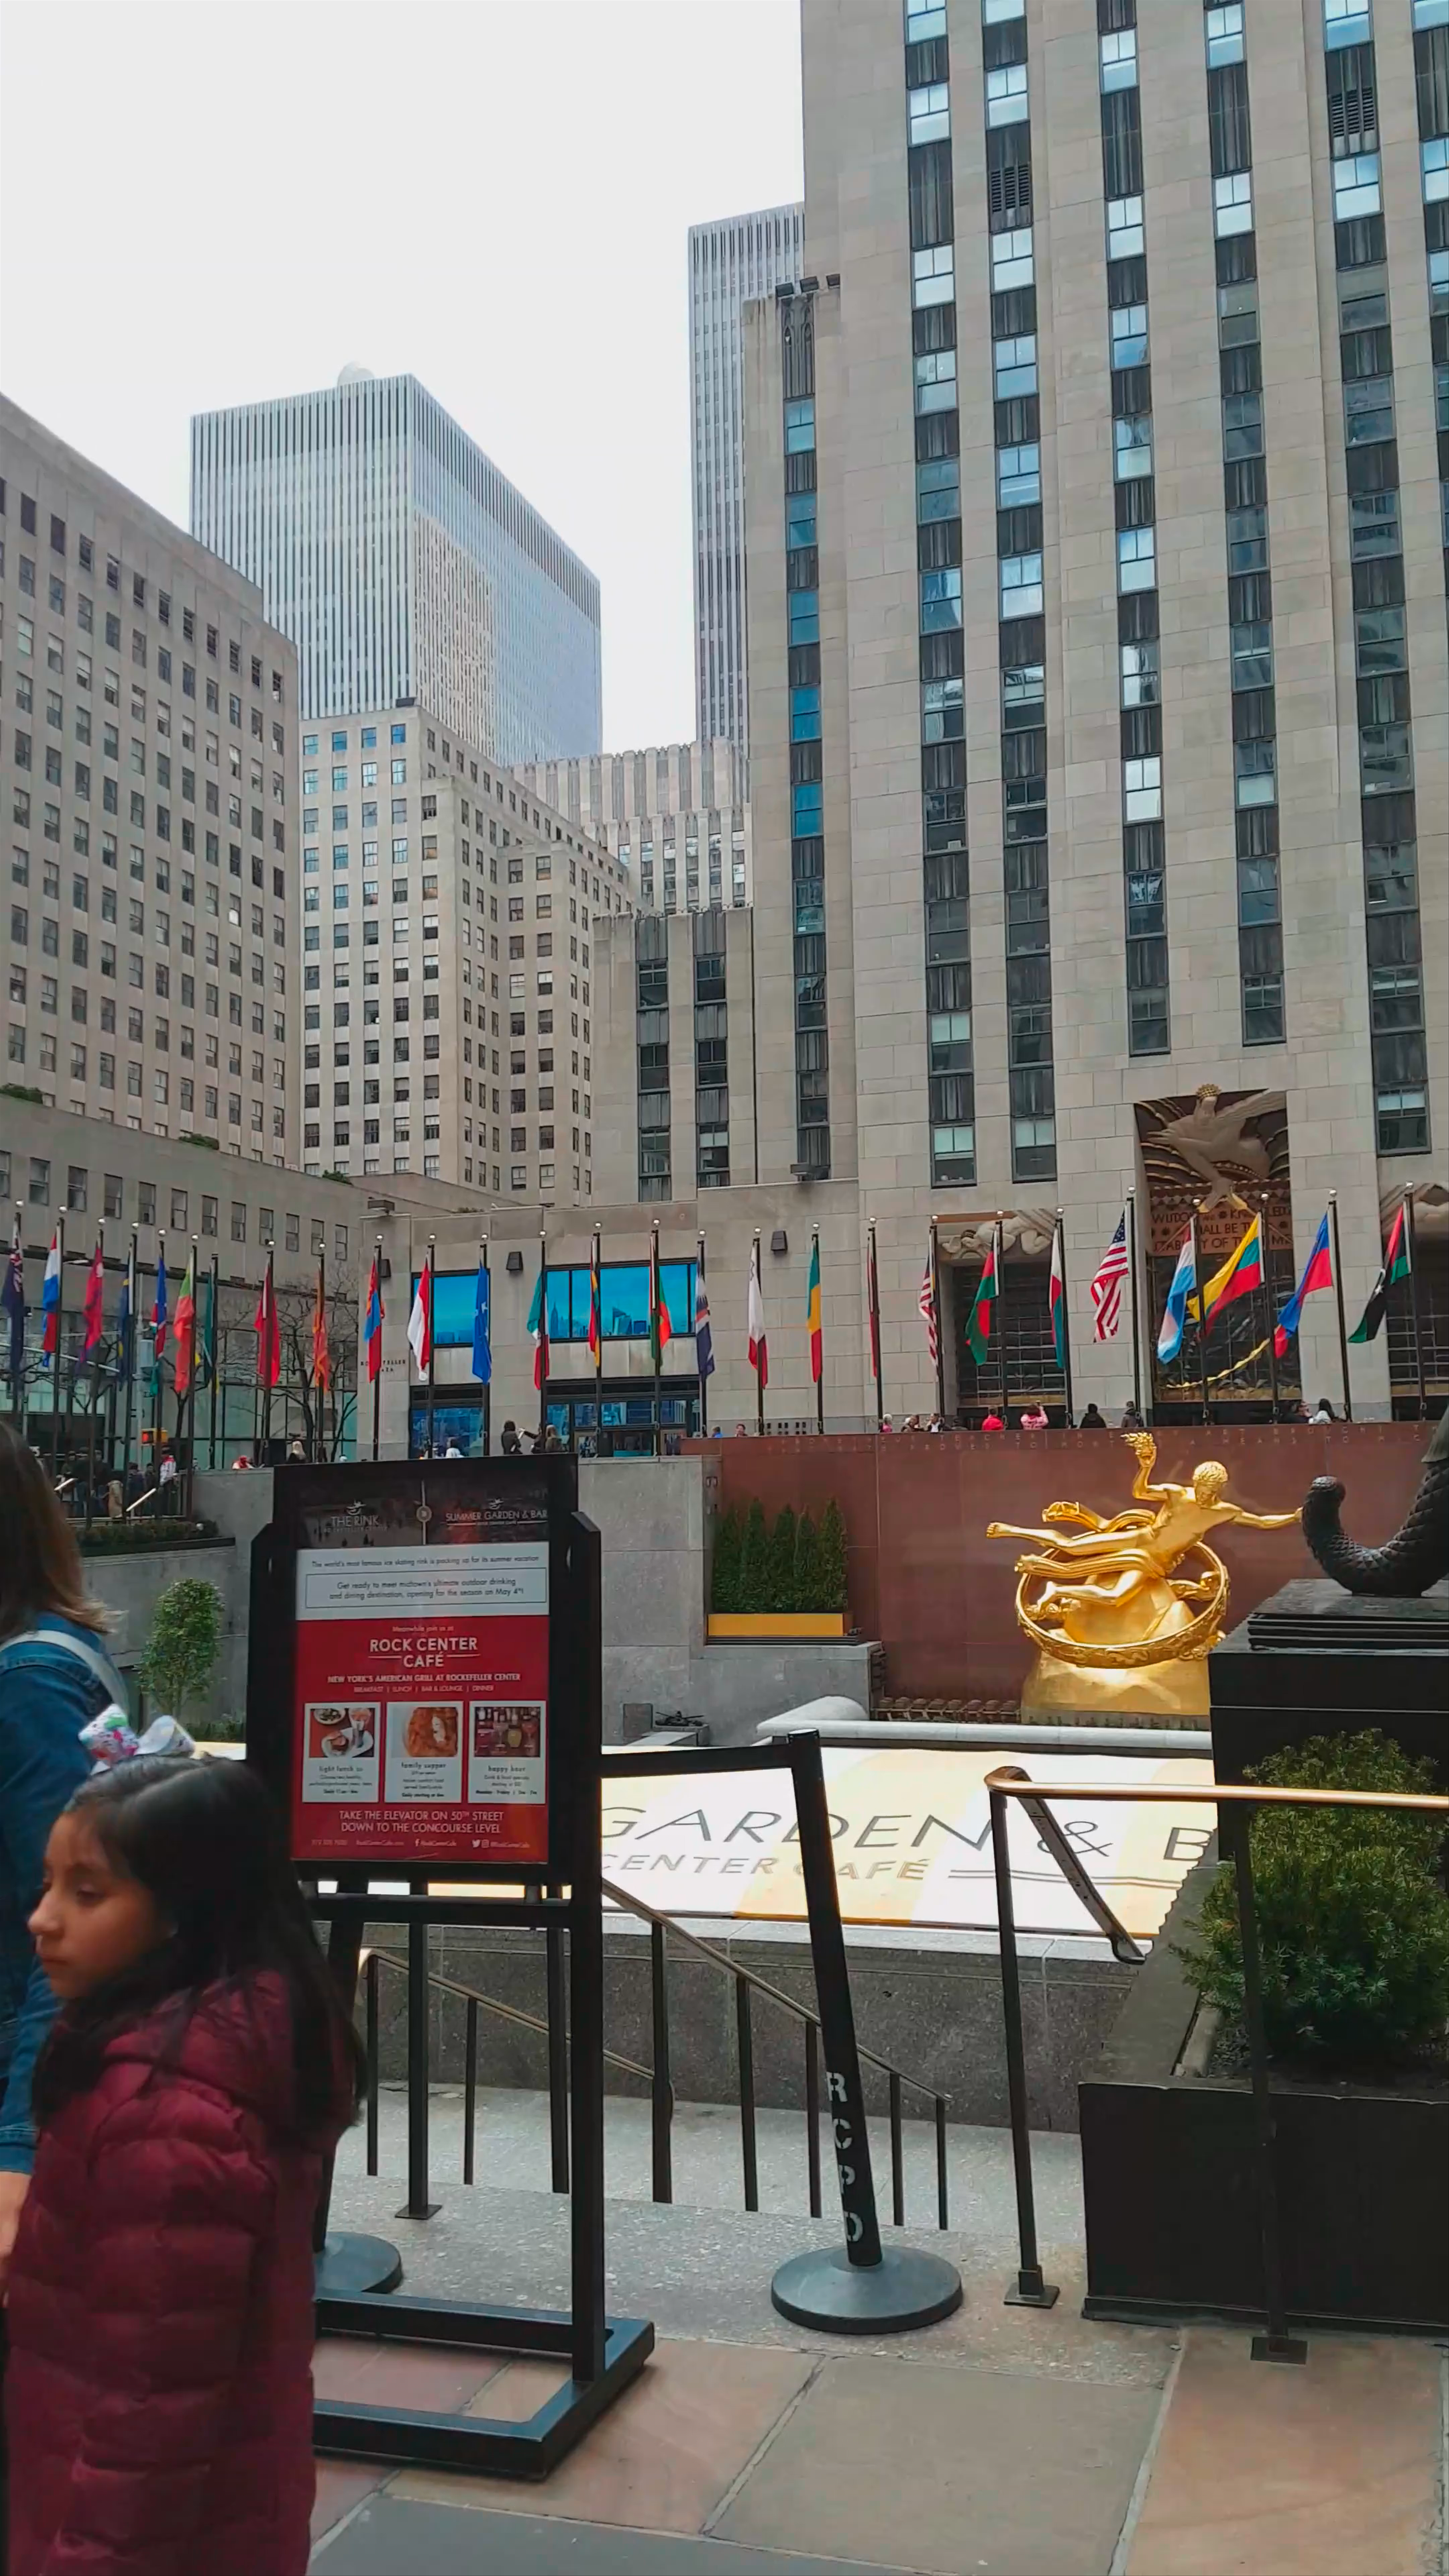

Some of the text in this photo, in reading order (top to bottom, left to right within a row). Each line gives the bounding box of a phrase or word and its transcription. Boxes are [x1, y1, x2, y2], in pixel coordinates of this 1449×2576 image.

[1212, 1237, 1229, 1248] OF
[331, 1515, 380, 1527] THE RINK
[446, 1510, 547, 1521] SUMMER GARDEN & BAR
[351, 1581, 370, 1590] ready
[489, 1577, 516, 1586] drinking
[344, 1592, 365, 1601] dining
[495, 1587, 511, 1596] May
[369, 1636, 478, 1652] ROCK CENTER
[403, 1651, 445, 1668] CAFÉ
[375, 1674, 413, 1682] AMERICAN
[446, 1673, 492, 1681] ROCKEFELLER
[339, 1810, 504, 1821] TAKE THE ELEVATOR ON 50TH STREET
[341, 1822, 501, 1833] DOWN TO THE CONCOURSE LEVEL
